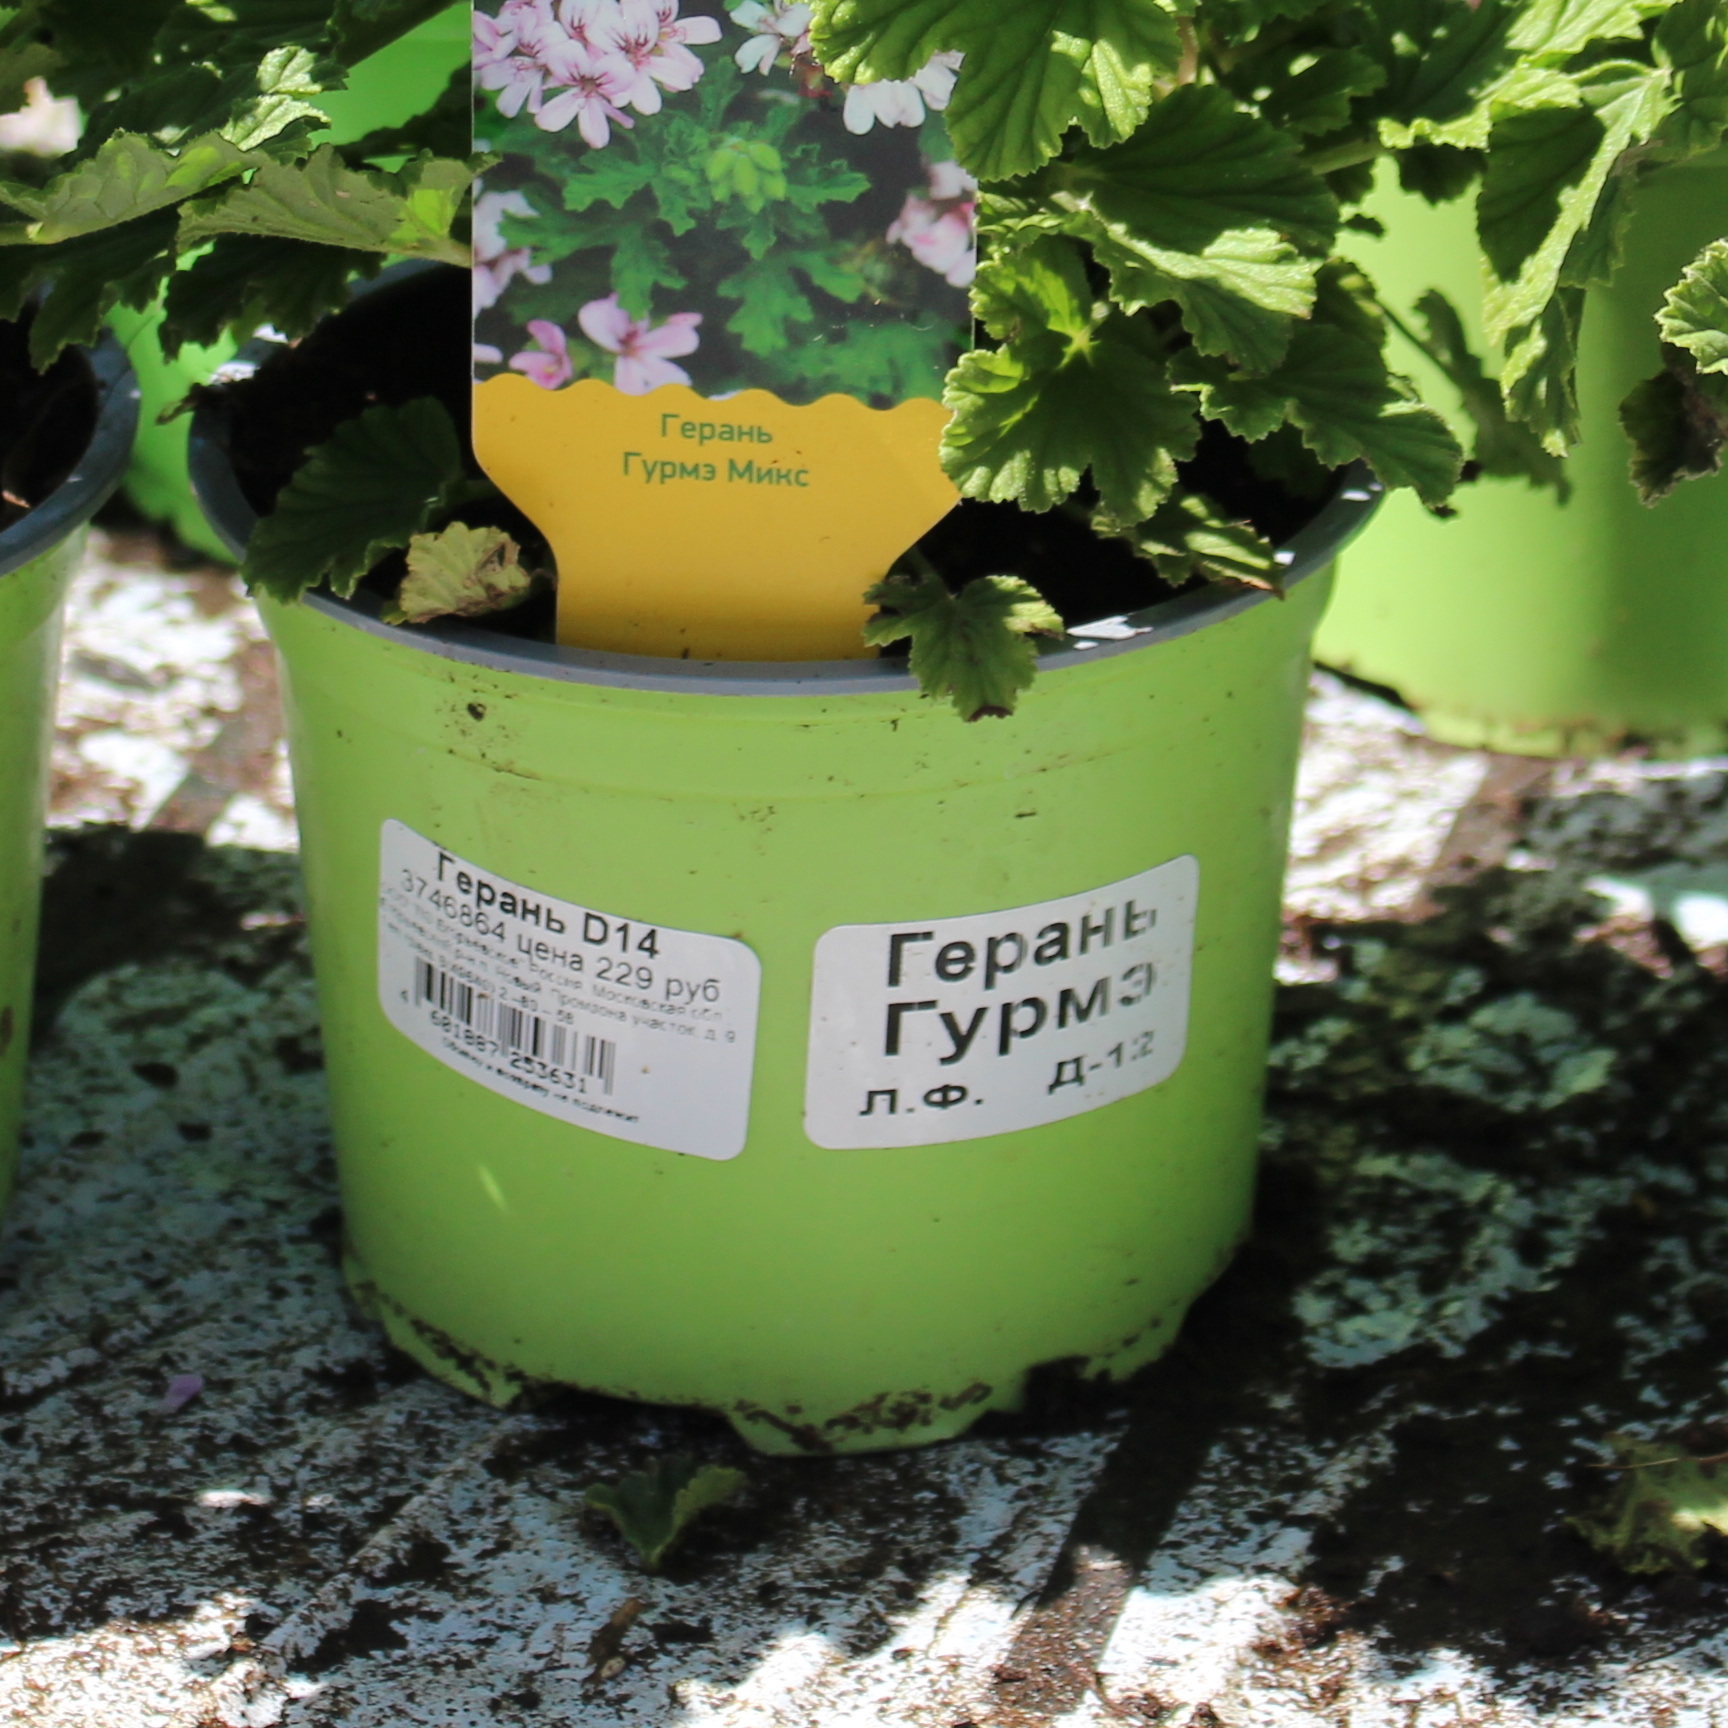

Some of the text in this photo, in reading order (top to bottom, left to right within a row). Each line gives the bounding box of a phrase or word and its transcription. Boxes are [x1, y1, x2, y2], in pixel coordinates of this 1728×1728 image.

[622, 452, 810, 488] Гурмэ Микс
[661, 413, 774, 446] Герань
[401, 868, 506, 943] 3746864
[517, 933, 584, 972] цена
[596, 957, 653, 991] 229
[665, 976, 722, 1004] руб
[436, 851, 566, 934] Герань
[583, 912, 660, 959] D14
[886, 899, 1157, 990] Герань
[884, 962, 1158, 1065] Гурмэ
[510, 1050, 587, 1094] 253631
